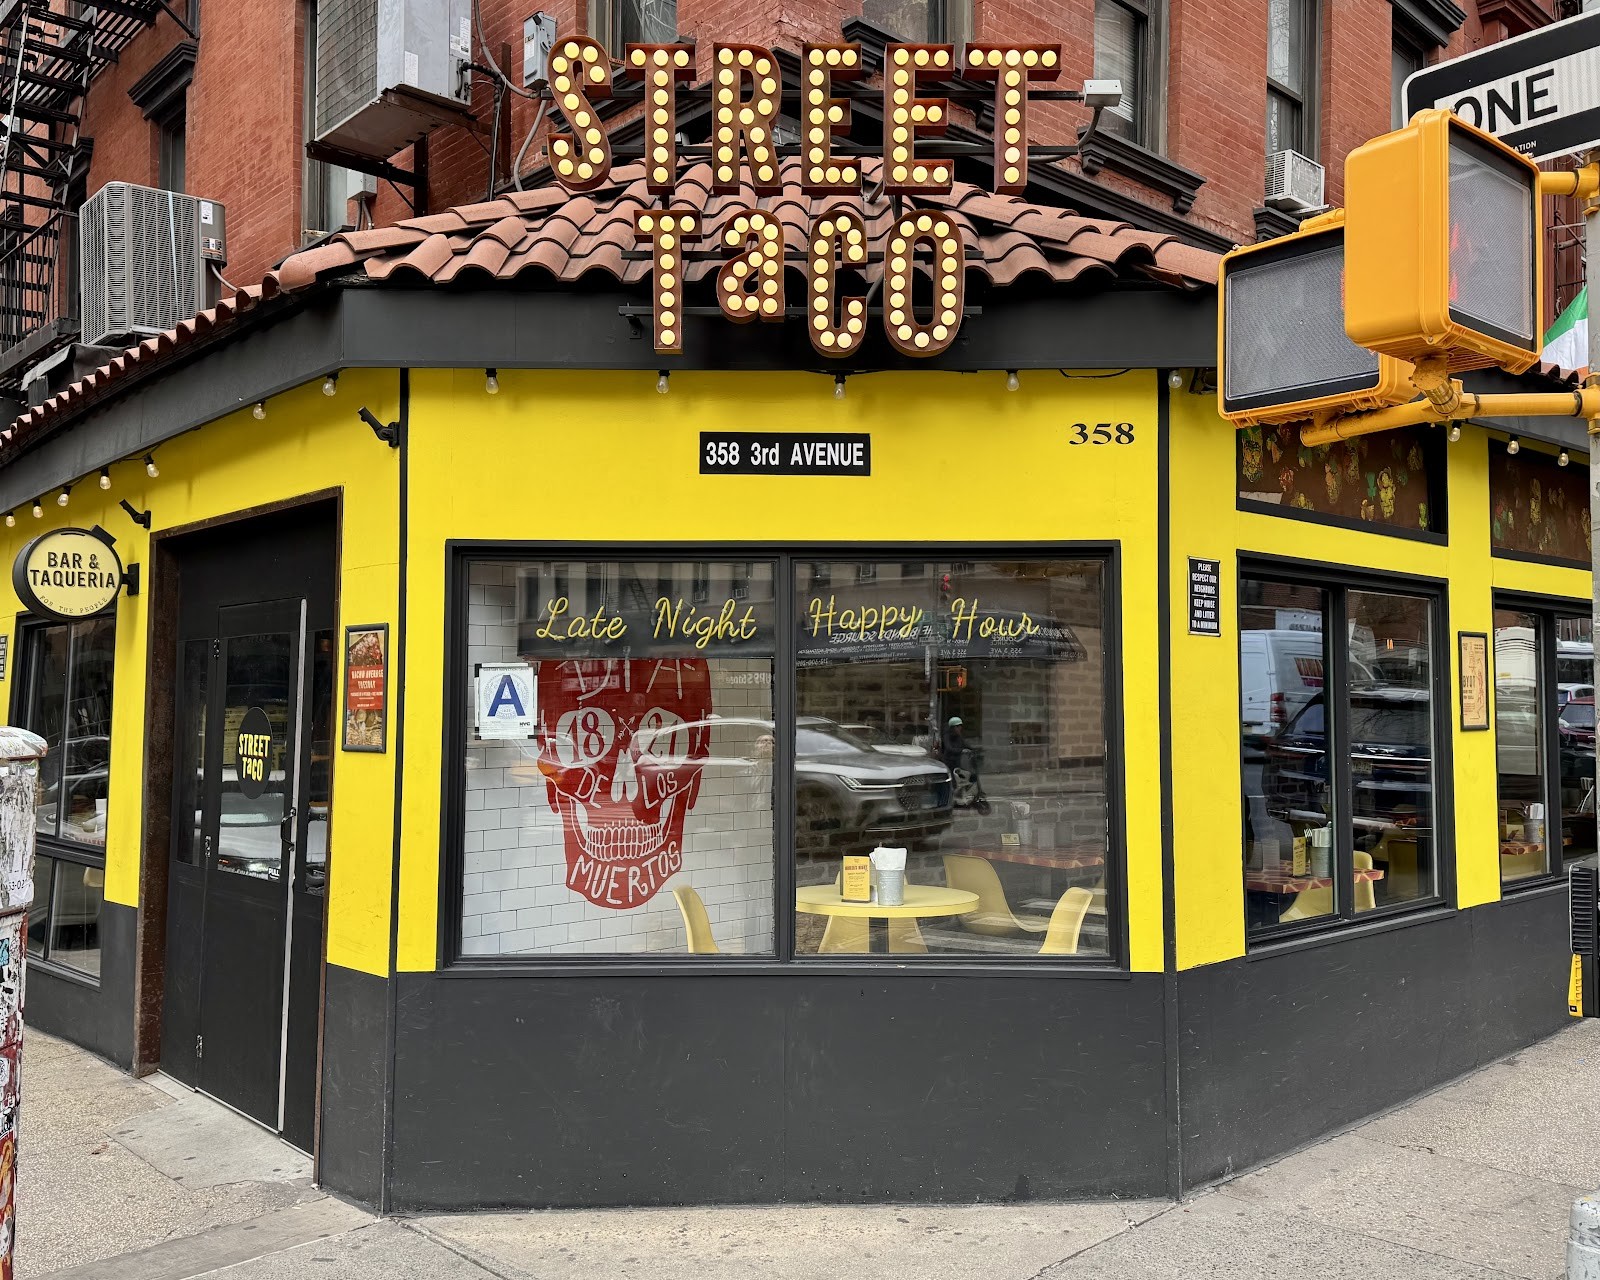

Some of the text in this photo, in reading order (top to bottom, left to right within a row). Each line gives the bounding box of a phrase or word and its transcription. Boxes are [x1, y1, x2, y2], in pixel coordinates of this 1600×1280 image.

[1454, 68, 1558, 133] ONE
[547, 35, 1062, 195] STREET
[1069, 422, 1135, 445] 358
[706, 442, 864, 466] 358 3rd AVENUE
[47, 551, 100, 570] BAR &
[1197, 562, 1212, 572] PLEASE
[30, 569, 116, 588] TAQUERIA
[1191, 572, 1209, 583] RESPECT
[39, 595, 108, 614] FOR THE PEOPLE
[536, 597, 757, 649] Late Night
[809, 595, 1040, 641] Happy Hour
[487, 674, 526, 717] A
[238, 733, 271, 758] STREET
[566, 711, 679, 763] 18 21
[575, 766, 678, 809] DE LOS
[268, 867, 280, 877] PULL
[569, 840, 682, 904] MUERTOS
